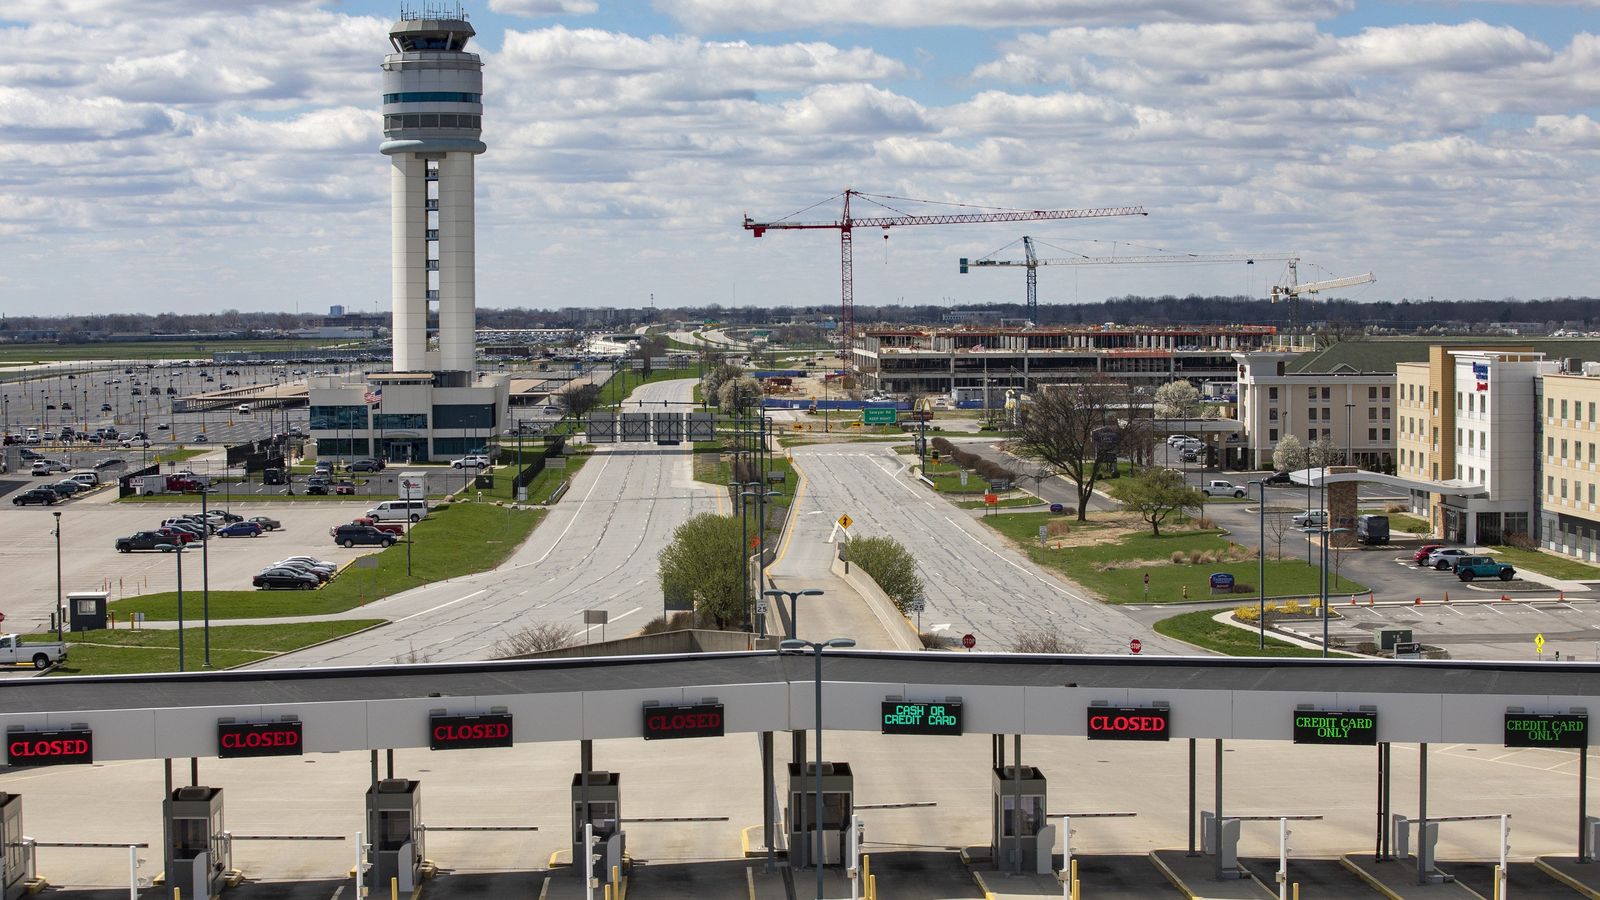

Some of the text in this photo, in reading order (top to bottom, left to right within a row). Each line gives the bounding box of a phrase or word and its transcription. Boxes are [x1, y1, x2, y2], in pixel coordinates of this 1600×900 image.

[896, 705, 945, 716] CASH OR
[647, 713, 720, 730] CLOSED
[884, 714, 957, 726] CREDIT CARD
[1090, 716, 1165, 731] CLOSED
[1296, 717, 1373, 729] CREDIT CARD
[1506, 720, 1584, 731] CREDIT CARD
[434, 723, 510, 740] CLOSED
[1317, 727, 1351, 738] ONLY
[1528, 730, 1561, 741] ONLY
[221, 731, 298, 748] CLOSED
[10, 740, 89, 757] CLOSED
